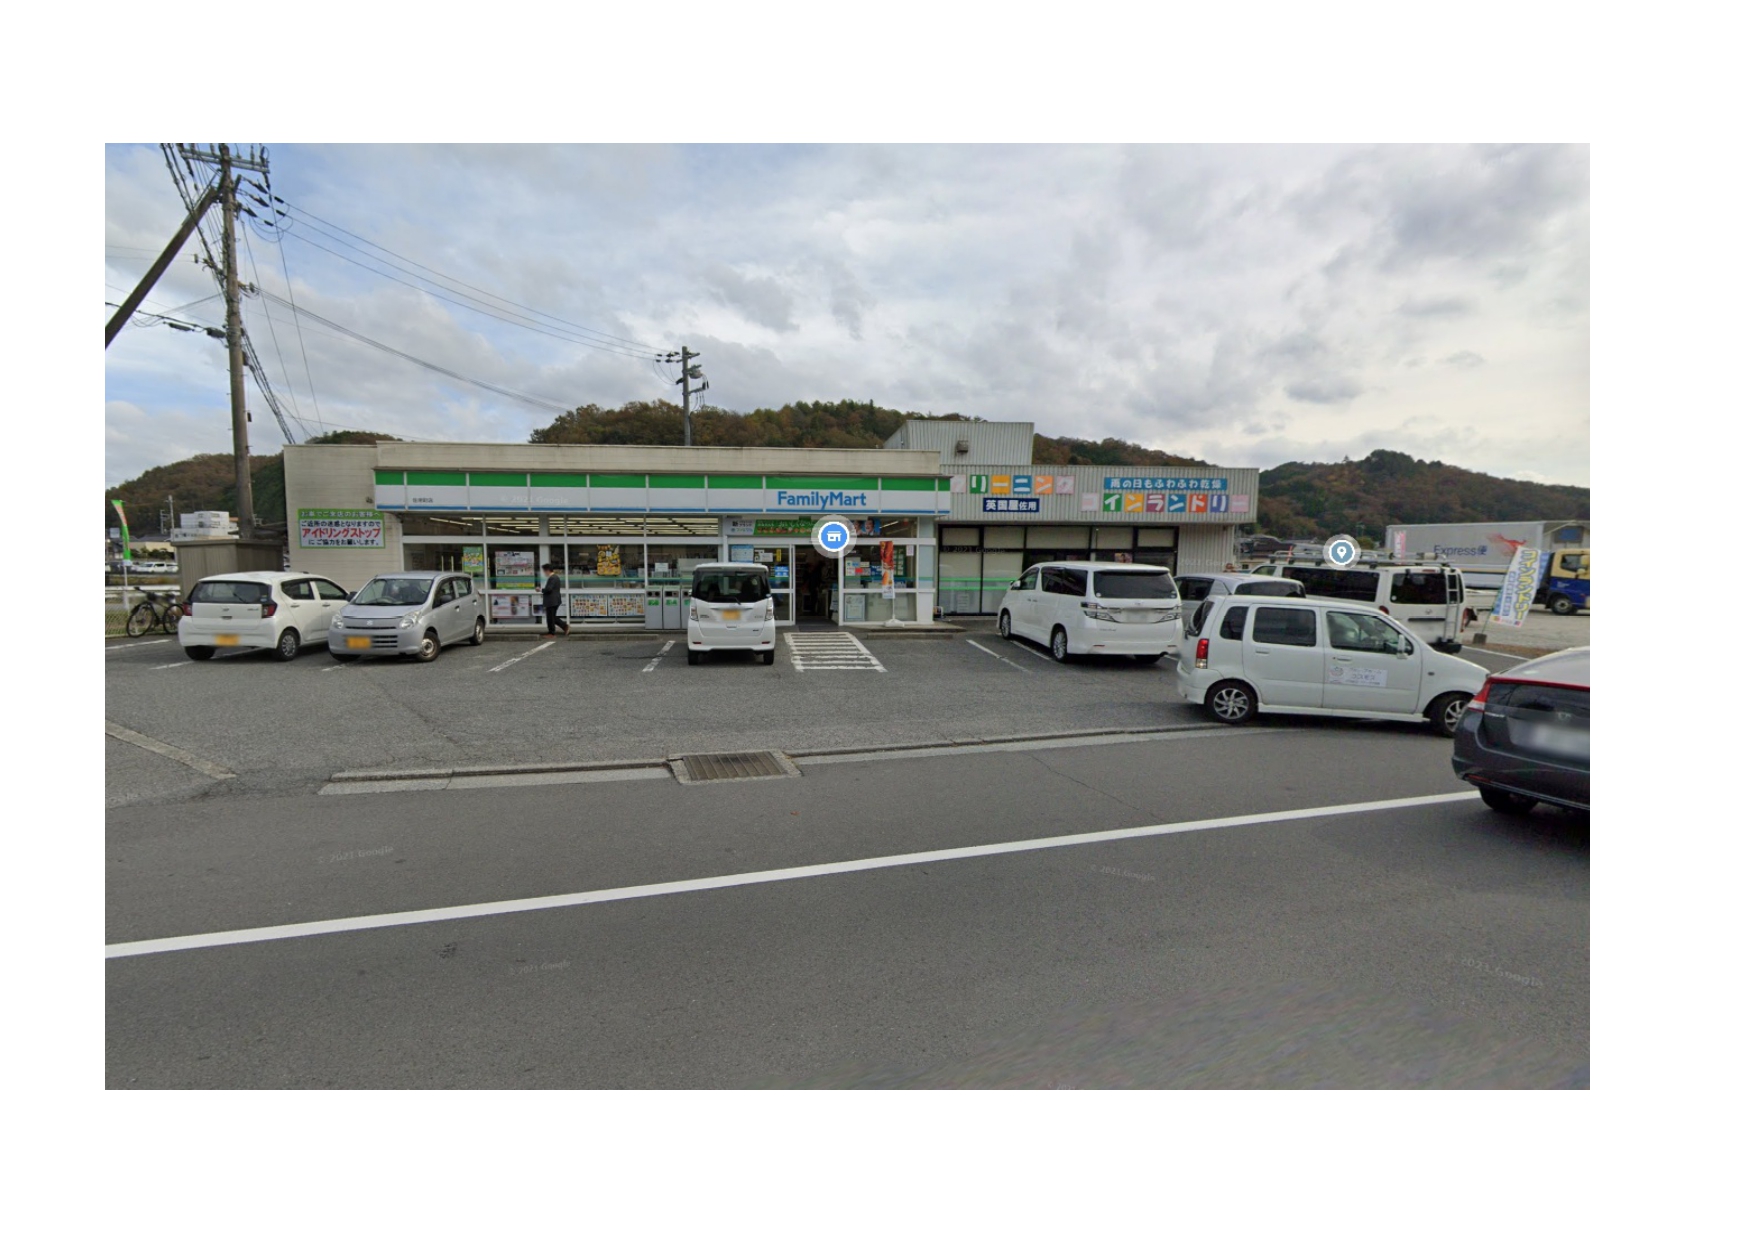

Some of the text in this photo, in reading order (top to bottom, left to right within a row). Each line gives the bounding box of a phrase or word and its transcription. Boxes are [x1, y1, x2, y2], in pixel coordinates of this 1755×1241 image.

[1110, 478, 1222, 489] 雨の日もふわふわ乾燥
[777, 490, 867, 510] FamilyMart
[985, 499, 1037, 511] 英国屋佐用
[1081, 494, 1248, 512] コインランドリー
[302, 528, 381, 538] アイドリングストップ
